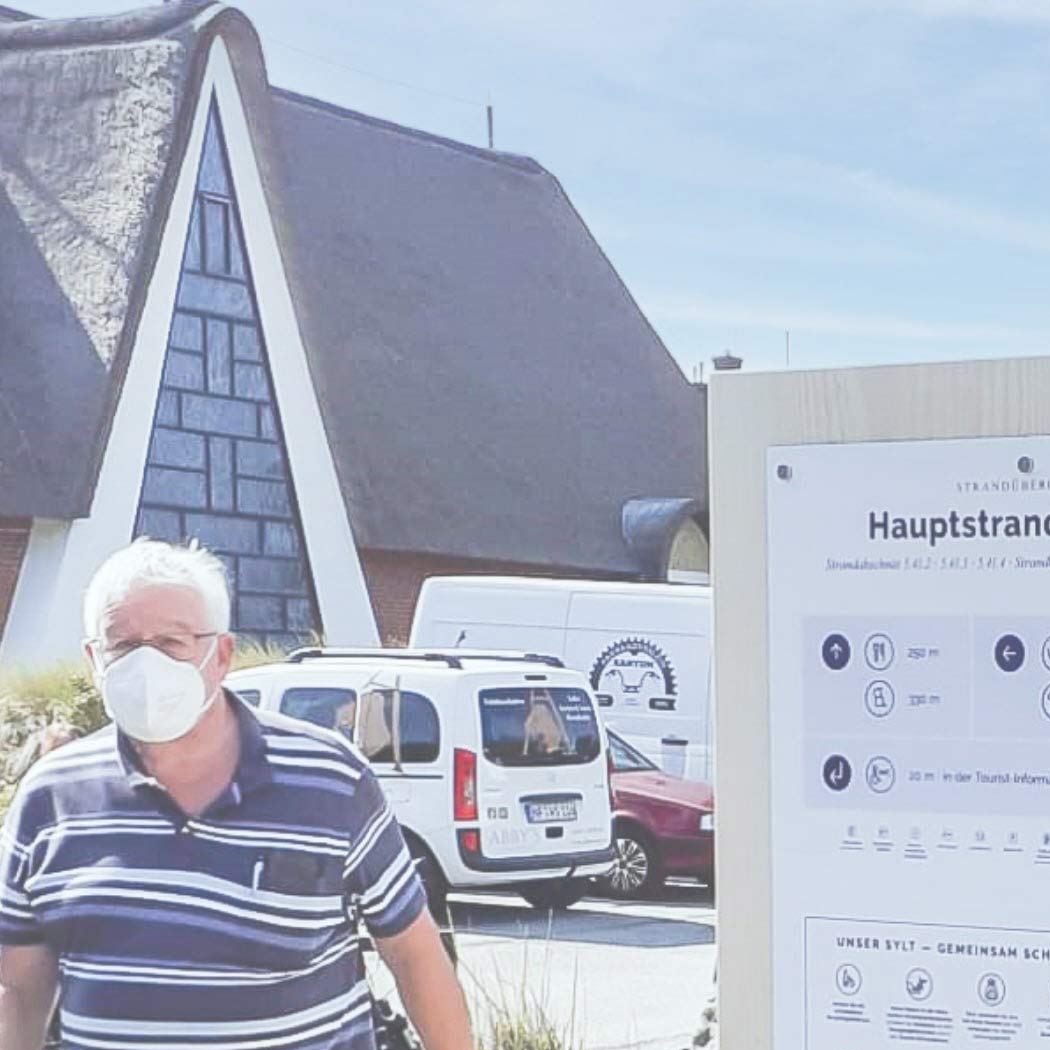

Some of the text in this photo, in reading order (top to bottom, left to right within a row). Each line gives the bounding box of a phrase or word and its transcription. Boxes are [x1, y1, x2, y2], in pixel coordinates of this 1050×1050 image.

[836, 937, 880, 950] UNSER
[885, 939, 916, 952] SYLT
[937, 942, 1018, 959] GEMEINSAM
